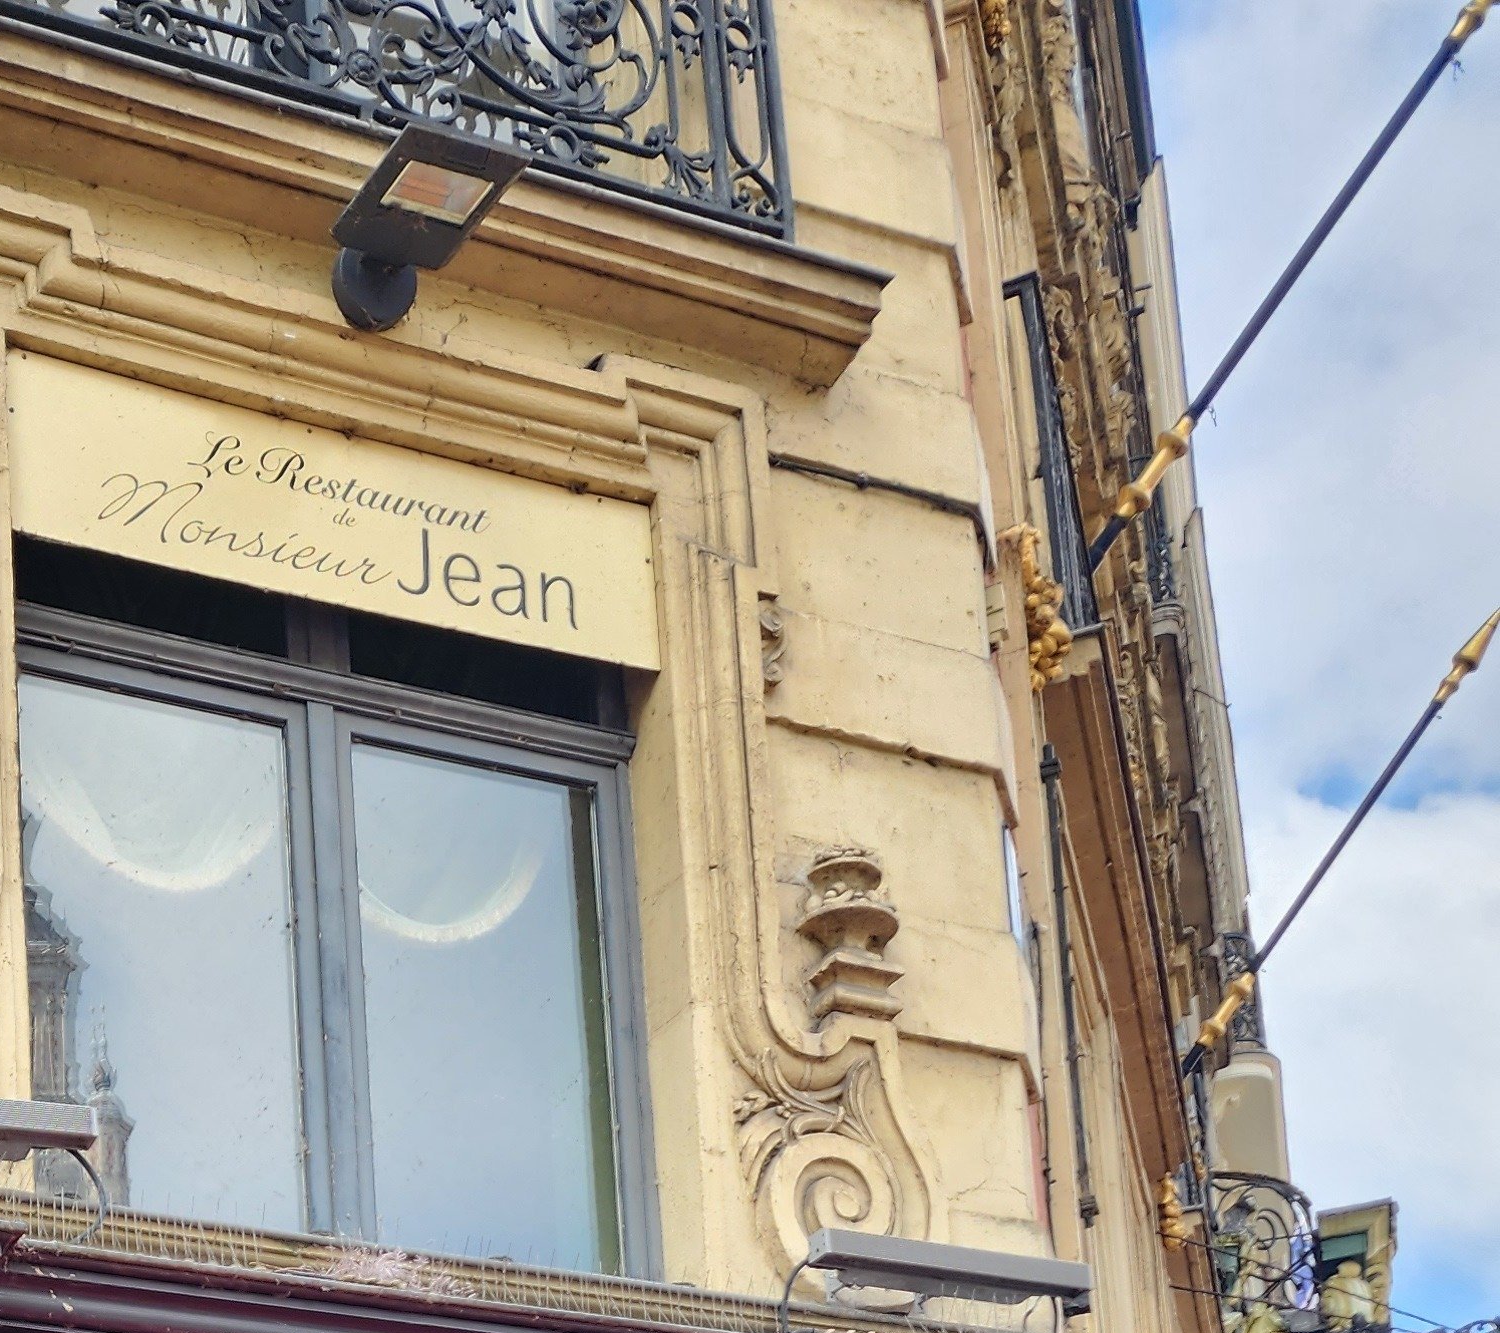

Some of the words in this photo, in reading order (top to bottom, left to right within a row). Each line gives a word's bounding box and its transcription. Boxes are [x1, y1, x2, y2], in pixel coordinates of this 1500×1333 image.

[188, 431, 250, 479] Le
[255, 446, 491, 534] Restaurant
[333, 508, 356, 528] de
[100, 473, 393, 585] Monsieur
[397, 528, 579, 631] Jean
